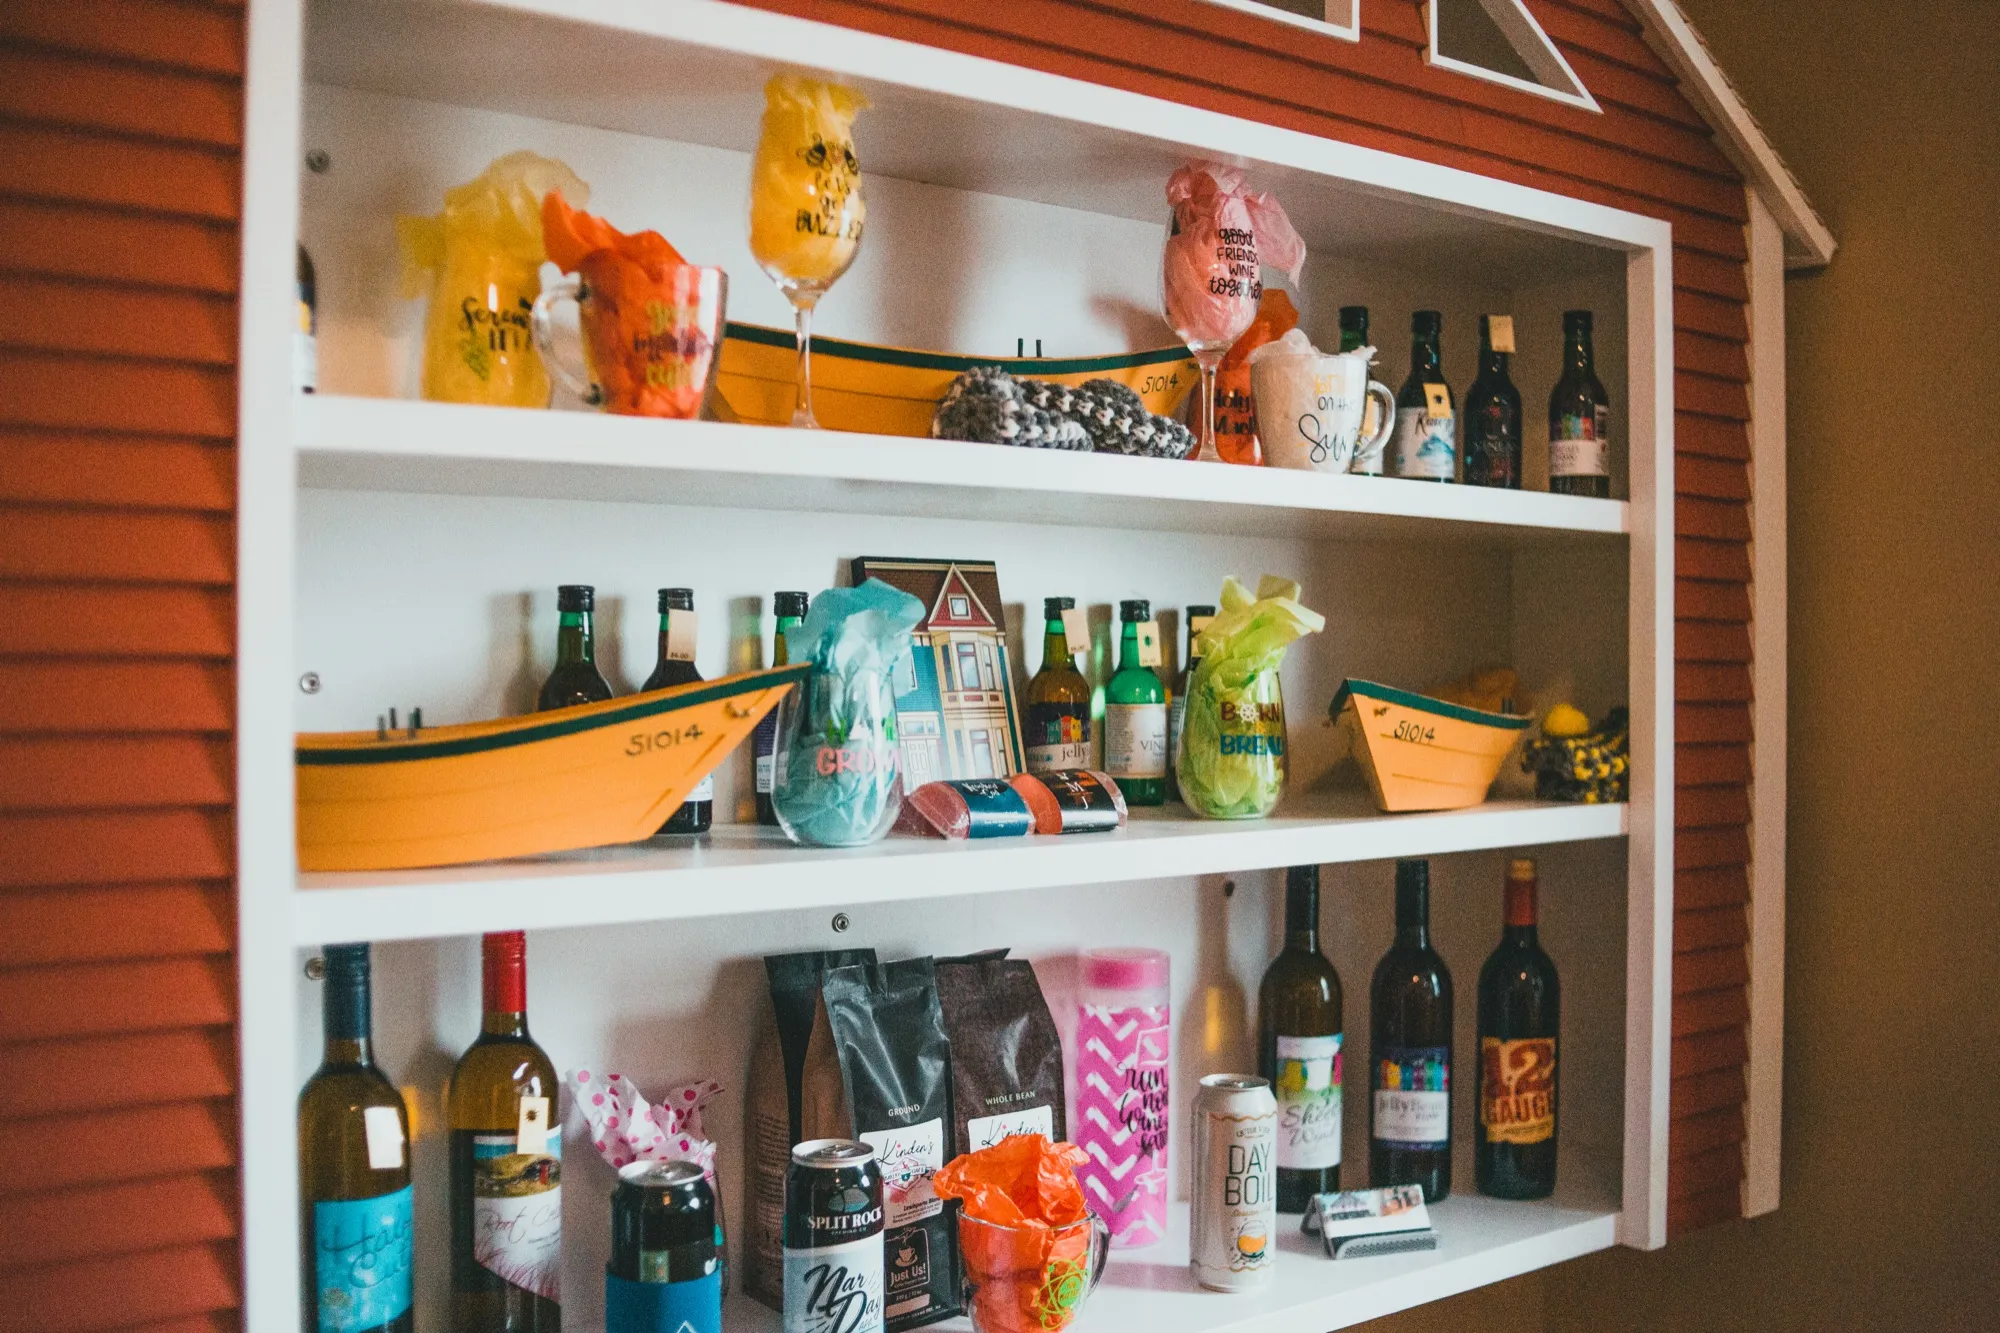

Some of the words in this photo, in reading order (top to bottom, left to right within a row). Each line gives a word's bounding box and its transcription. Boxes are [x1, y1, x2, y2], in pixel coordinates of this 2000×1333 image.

[1216, 246, 1259, 265] FRIENDS
[1228, 263, 1256, 279] WINE
[1209, 276, 1262, 300] togeher
[1317, 396, 1334, 411] on
[985, 1094, 1014, 1106] WHOLE
[1015, 1090, 1036, 1101] BEAN
[888, 1103, 920, 1117] GROUND
[1228, 1141, 1271, 1176] DAY
[1224, 1172, 1274, 1206] BOIL
[807, 1214, 849, 1230] SPLIT
[890, 1268, 909, 1287] Just
[911, 1262, 927, 1277] Us!
